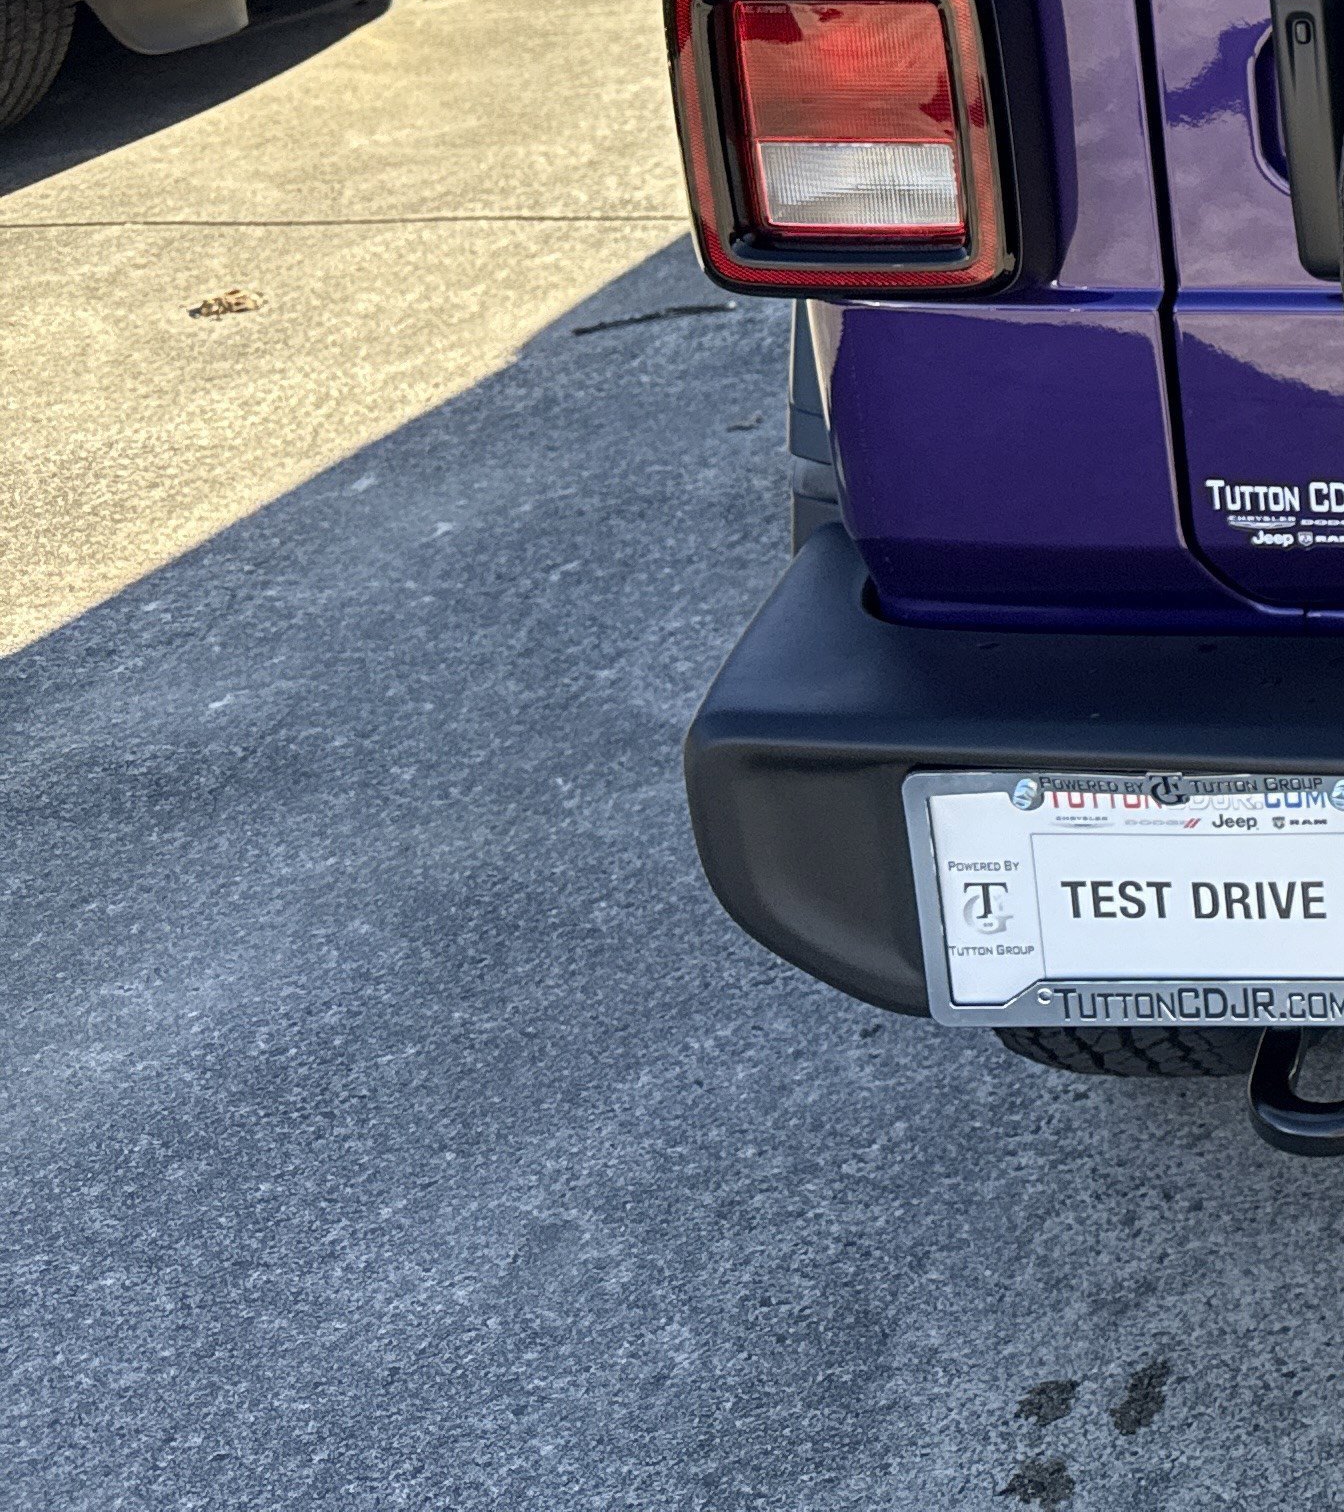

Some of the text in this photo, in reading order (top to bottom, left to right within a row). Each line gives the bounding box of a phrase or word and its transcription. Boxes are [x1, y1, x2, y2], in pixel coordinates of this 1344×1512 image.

[1251, 530, 1295, 548] Jeep
[1212, 813, 1258, 830] Jeep
[1290, 818, 1327, 826] RAM
[1060, 880, 1328, 920] TEST DRIVE
